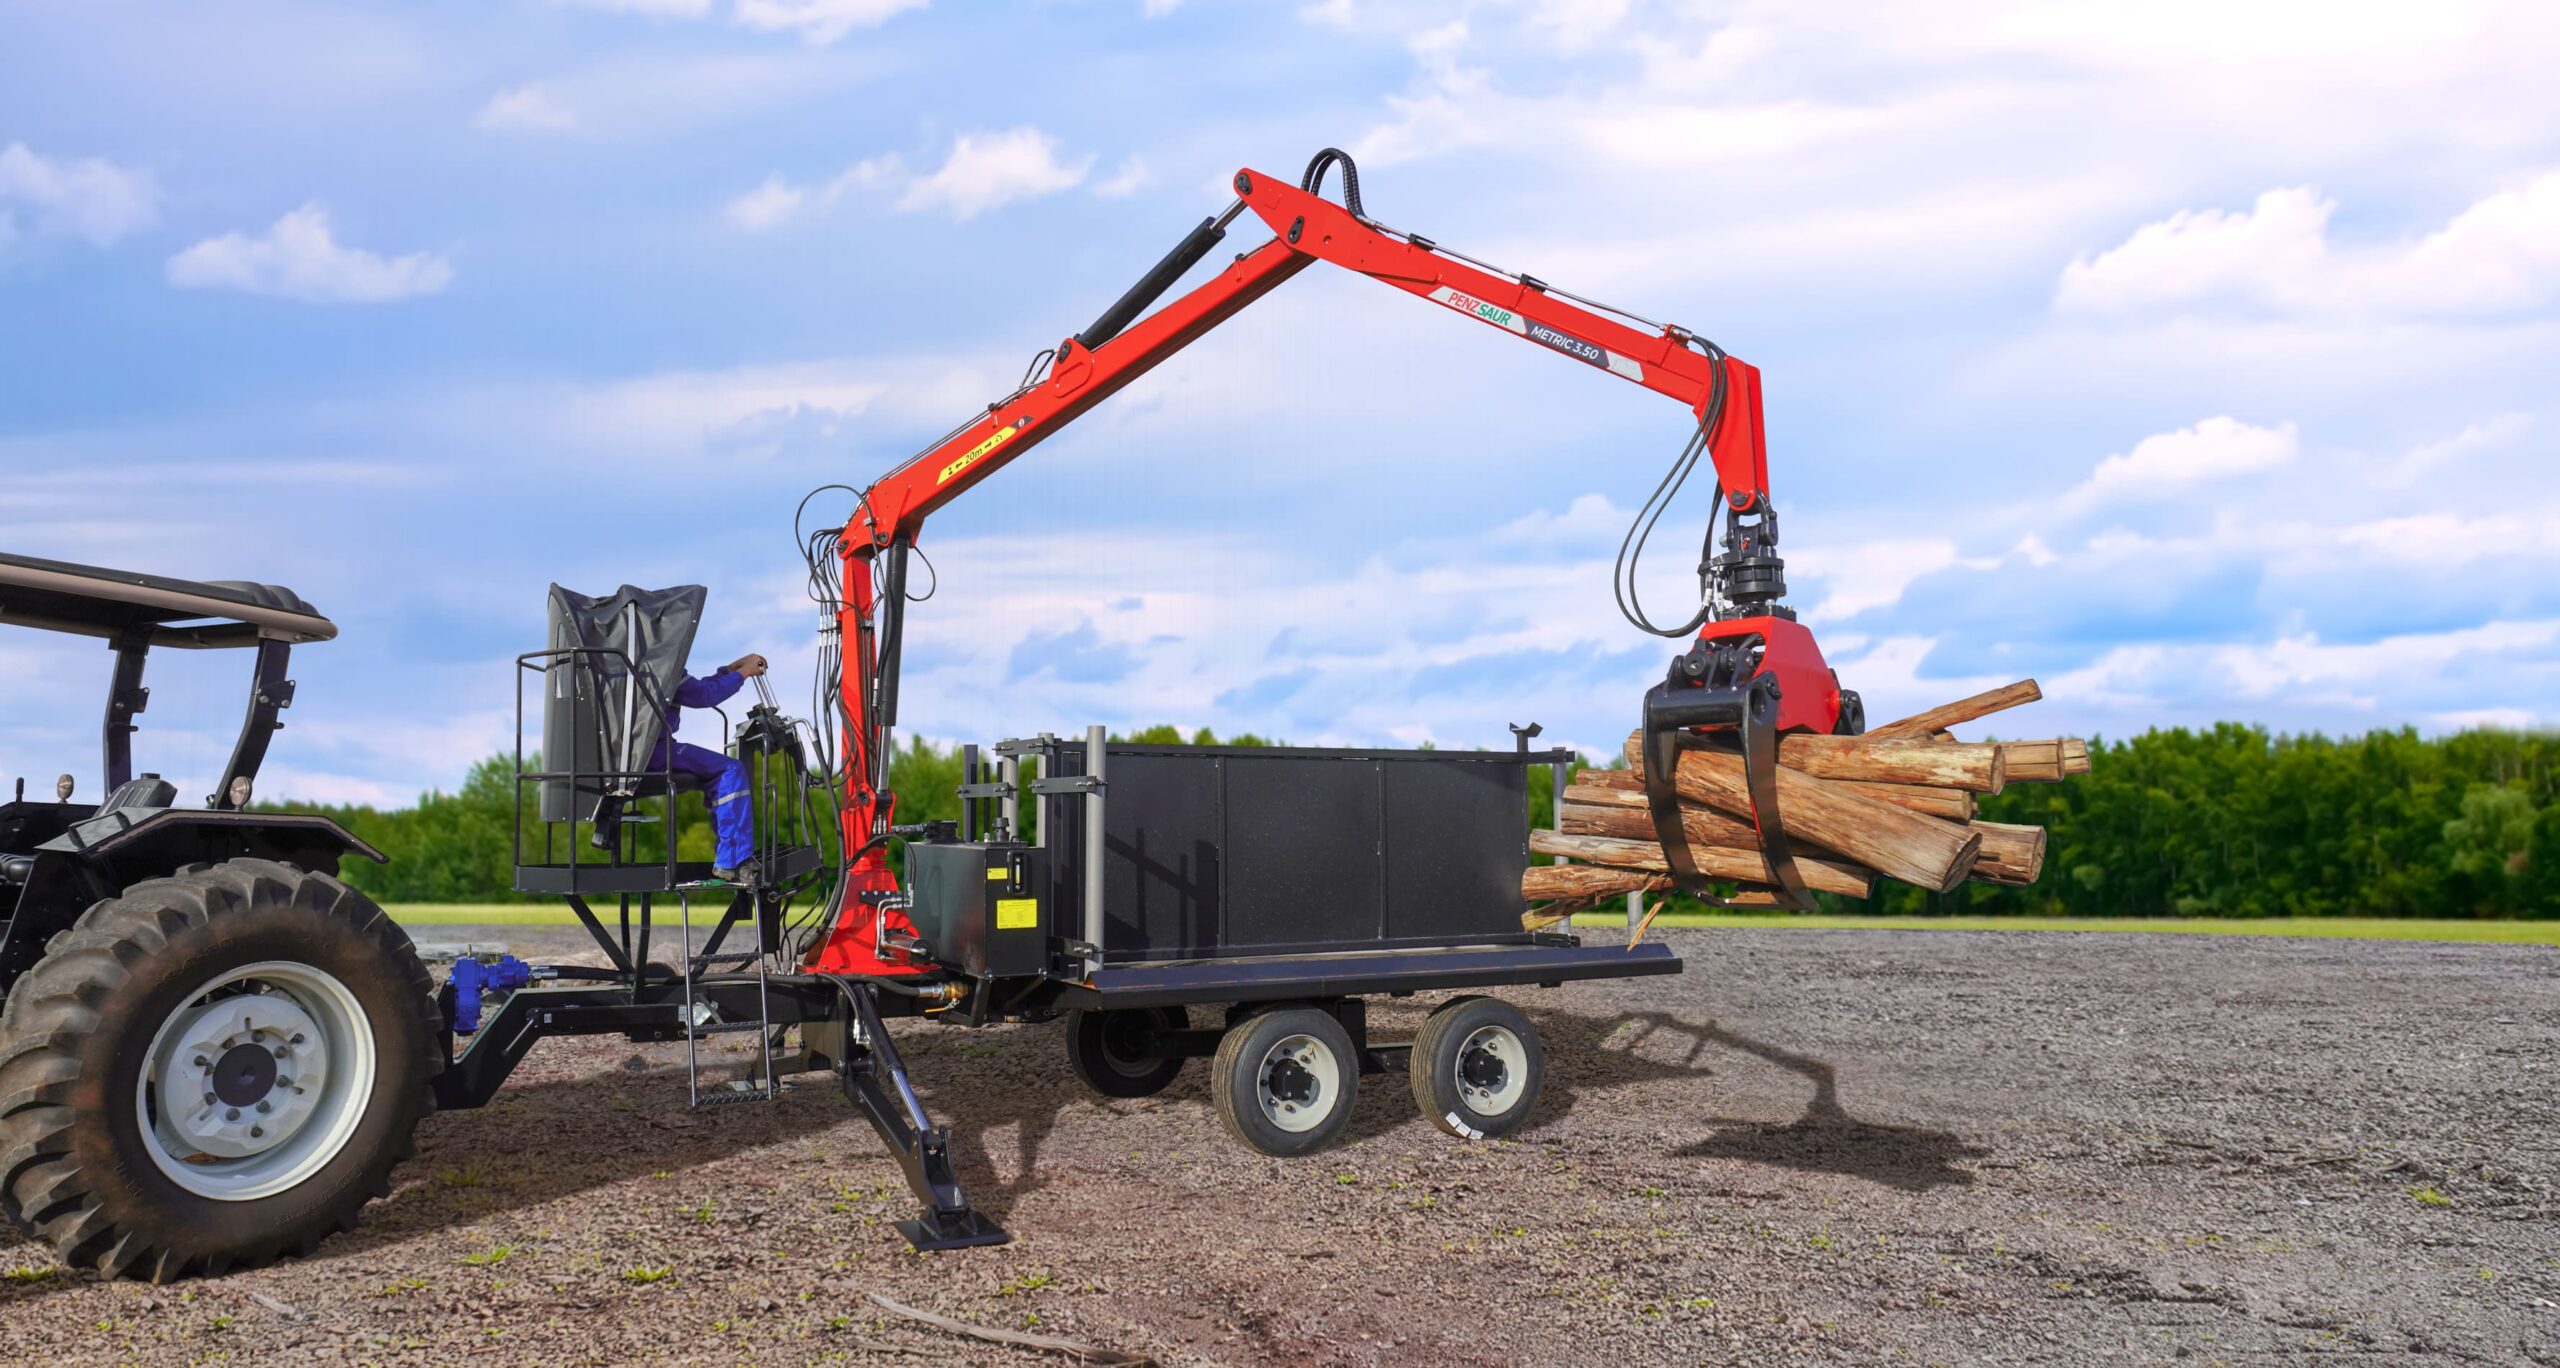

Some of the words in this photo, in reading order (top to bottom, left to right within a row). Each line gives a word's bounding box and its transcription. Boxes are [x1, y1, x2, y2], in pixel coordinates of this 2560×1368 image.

[1531, 326, 1573, 350] METRIC
[1572, 342, 1599, 360] 3.50
[965, 448, 982, 464] 20m
